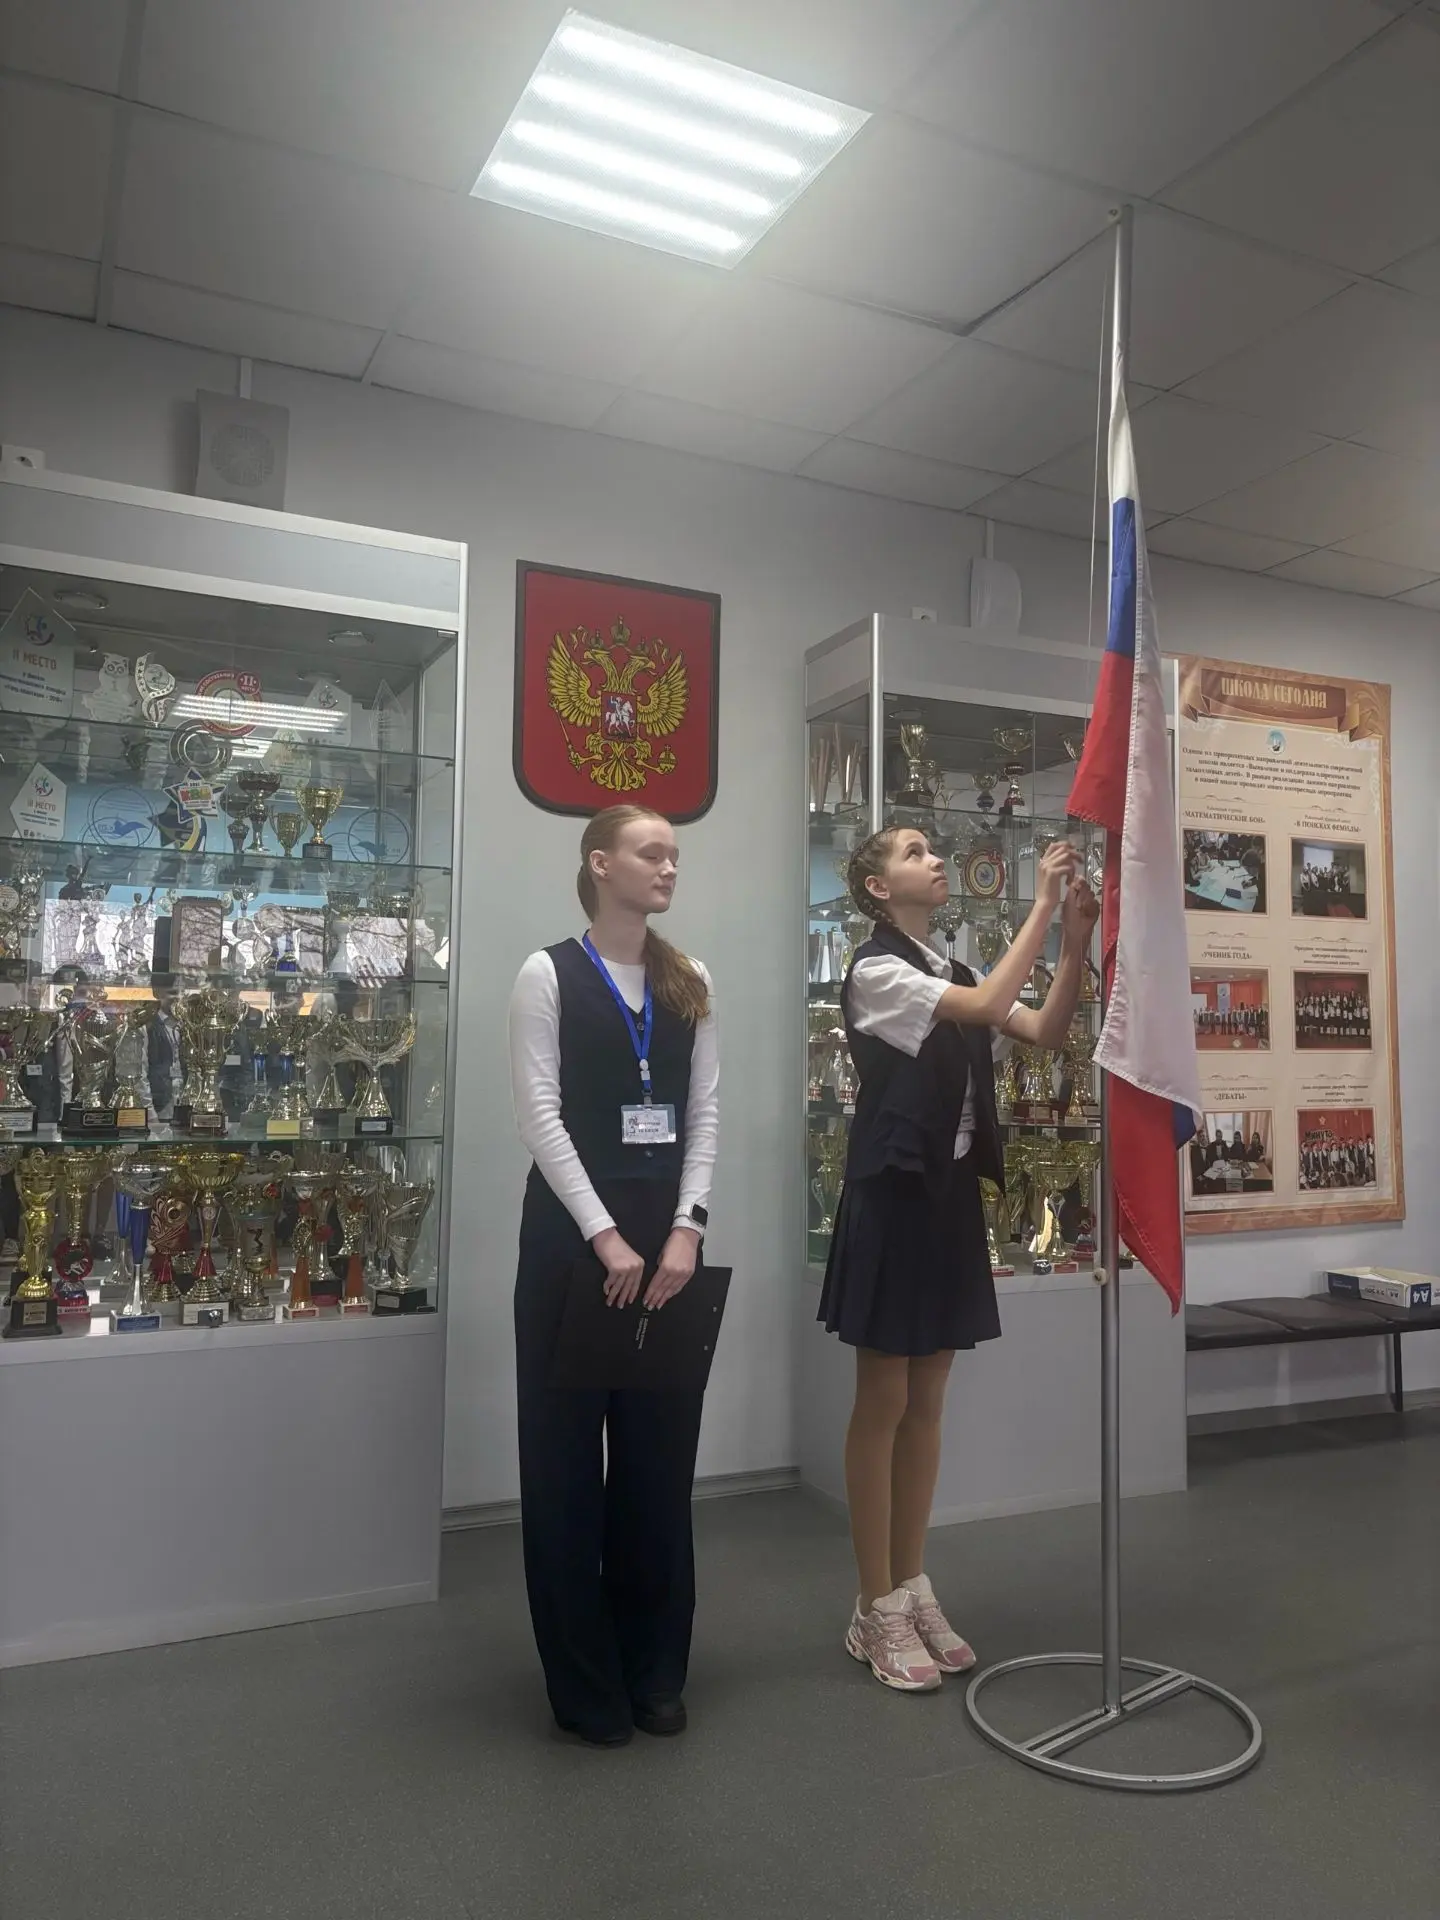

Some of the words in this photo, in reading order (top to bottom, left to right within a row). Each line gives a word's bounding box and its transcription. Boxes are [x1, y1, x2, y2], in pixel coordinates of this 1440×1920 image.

[23, 652, 57, 670] МЕСТО
[1221, 677, 1269, 700] ШКОЛА
[1273, 684, 1327, 709] СЕГОДНЯ
[1413, 1290, 1429, 1304] A4
